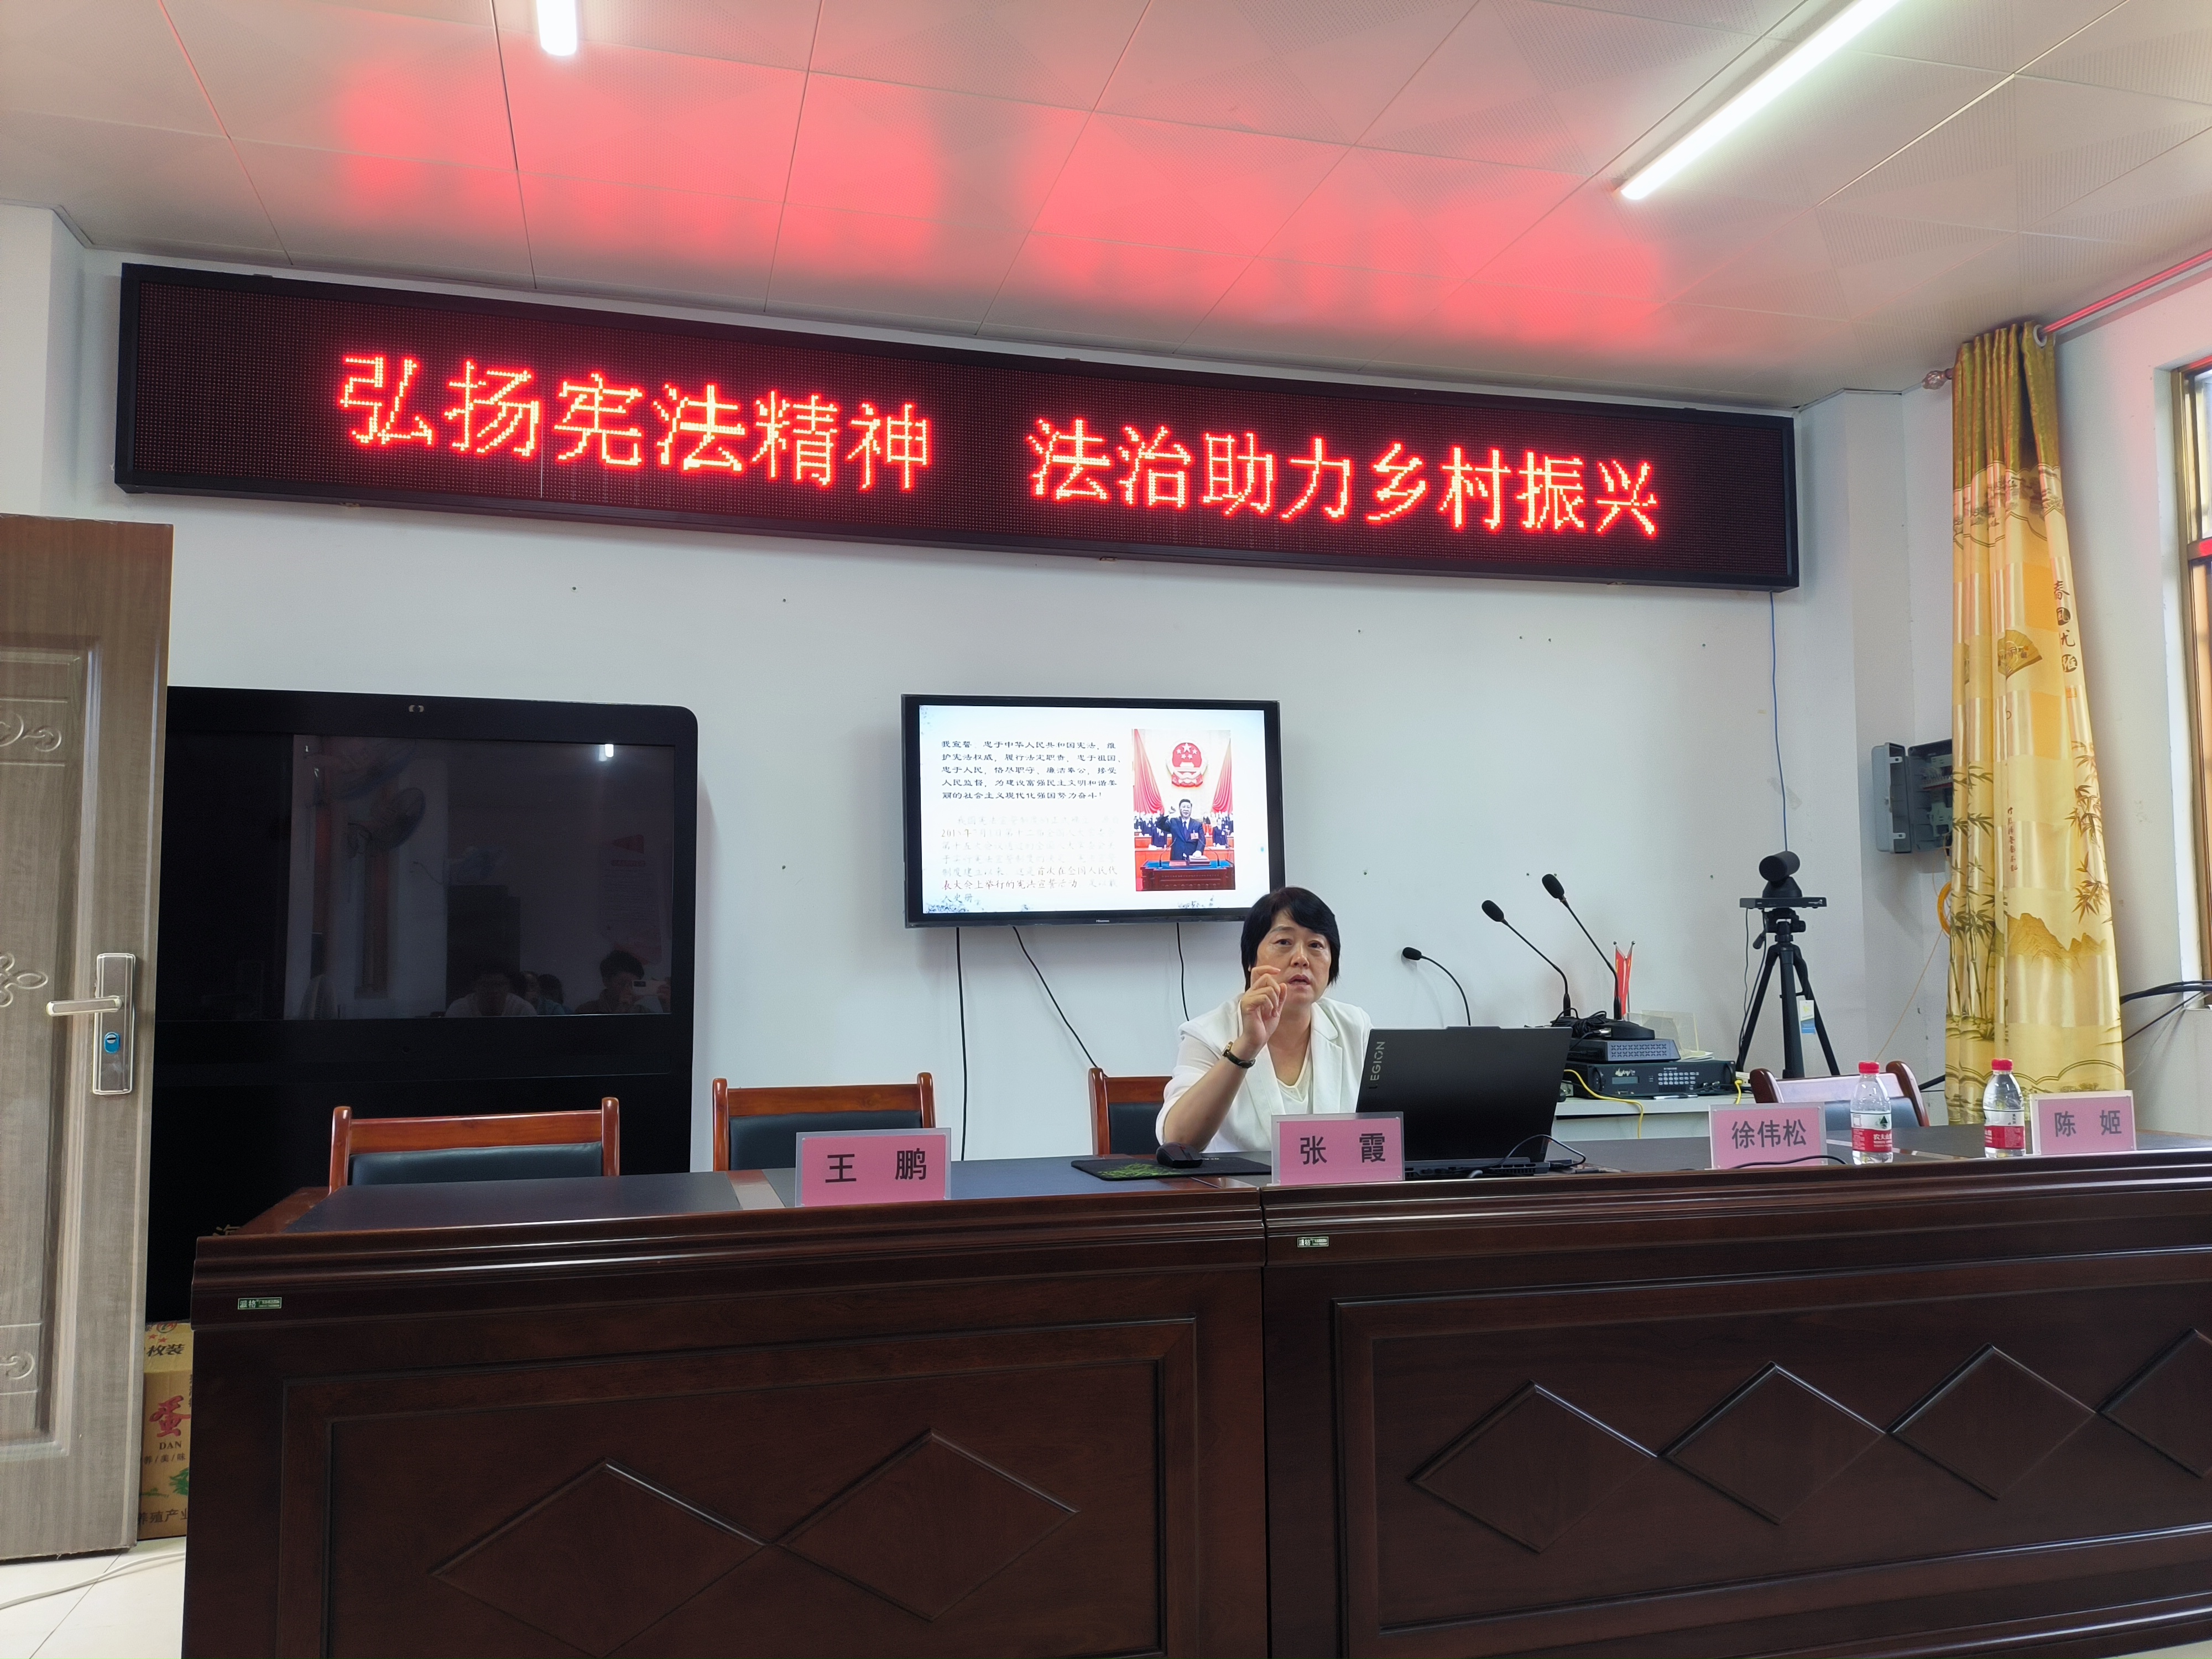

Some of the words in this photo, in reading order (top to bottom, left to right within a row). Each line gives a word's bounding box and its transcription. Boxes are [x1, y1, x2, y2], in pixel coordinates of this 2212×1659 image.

[340, 355, 930, 489] 弘扬宪法精神
[1027, 418, 1659, 536] 法治助力乡村振兴
[1731, 1119, 1807, 1149] 徐伟松
[144, 1344, 185, 1357] 枚装
[149, 1395, 191, 1437] 蛋
[159, 1440, 182, 1450] DAN
